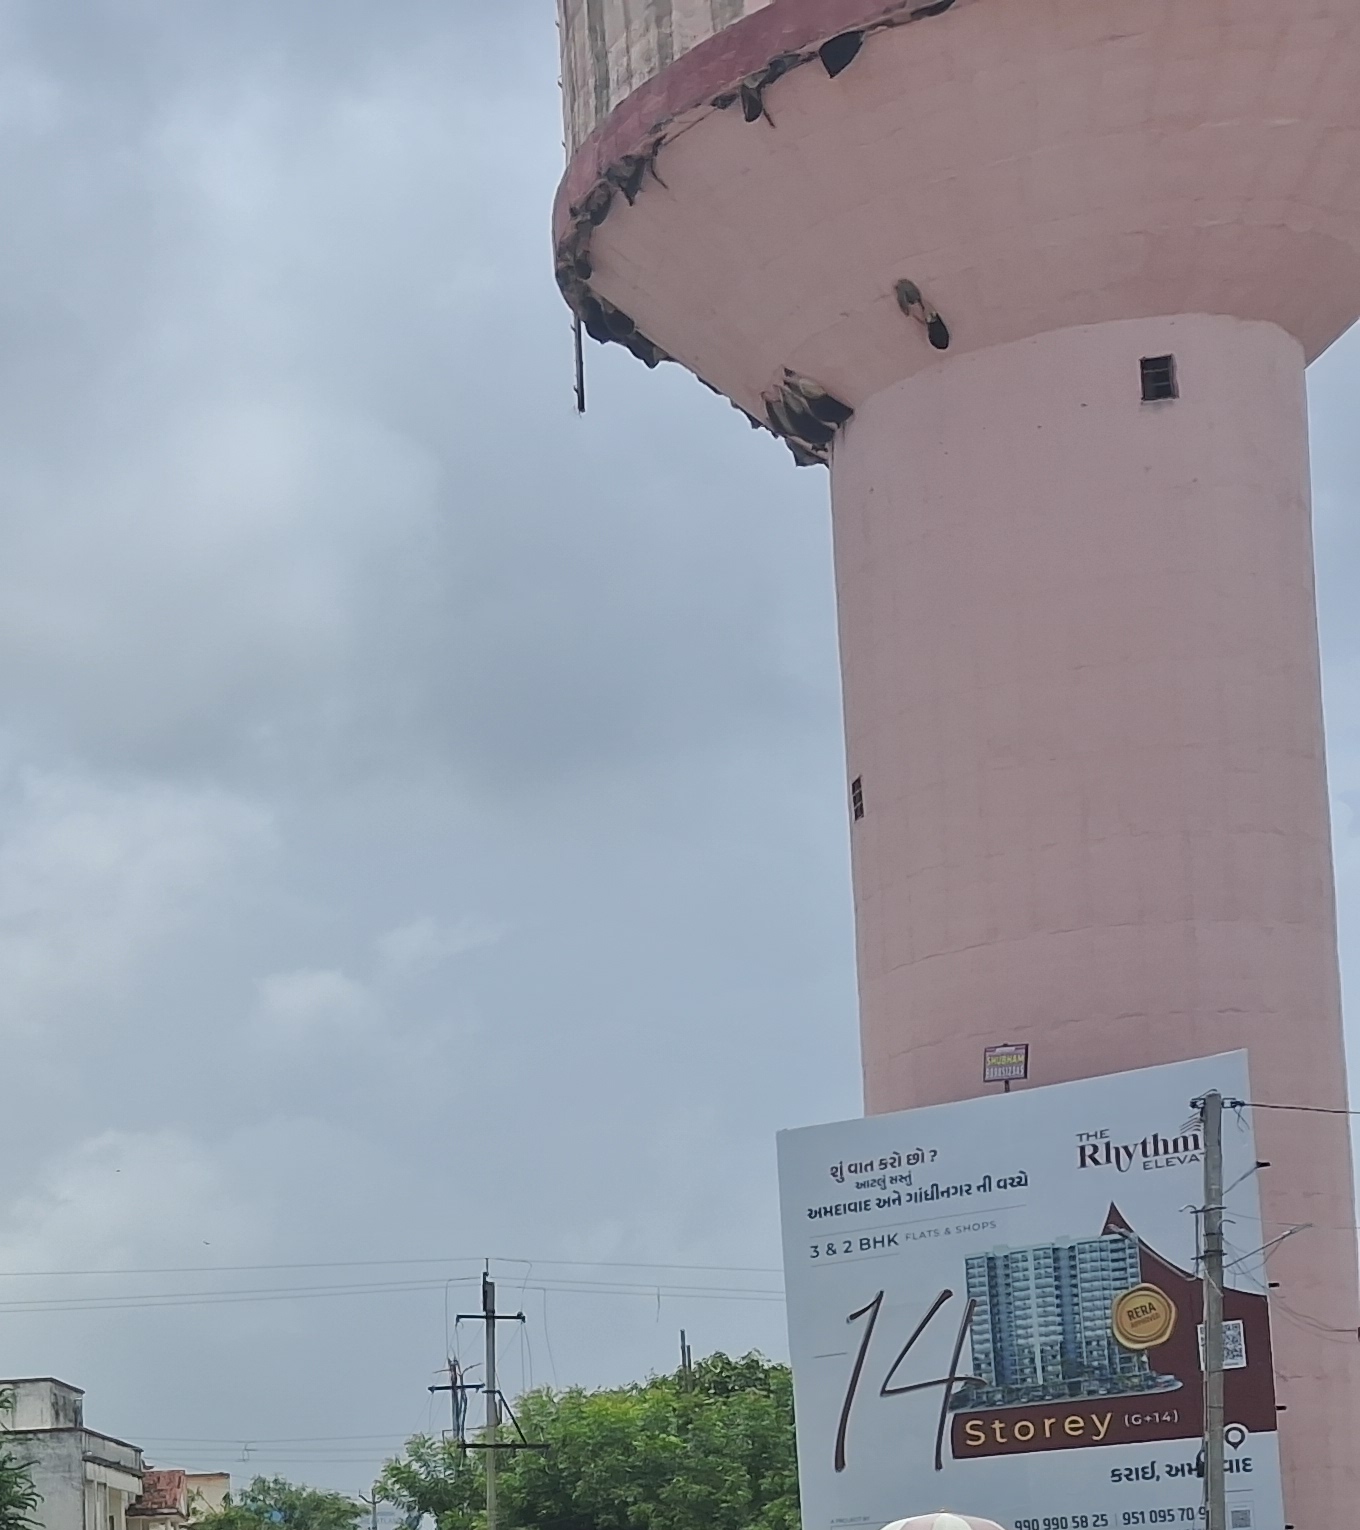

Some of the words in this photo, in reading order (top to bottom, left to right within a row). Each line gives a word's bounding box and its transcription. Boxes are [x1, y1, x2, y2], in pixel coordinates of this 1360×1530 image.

[1076, 1129, 1110, 1142] THE
[848, 1159, 874, 1175] વાત
[878, 1151, 902, 1171] કરો
[906, 1148, 925, 1167] છો
[1077, 1132, 1203, 1172] Rhythm
[1143, 1152, 1206, 1170] ELEVA
[807, 1199, 872, 1220] અમદાવાદ
[875, 1190, 902, 1209] અને
[905, 1183, 973, 1205] ગાંધીનગર
[976, 1175, 992, 1193] ની
[810, 1246, 820, 1259] 3
[825, 1243, 837, 1256] &
[843, 1240, 853, 1254] 2
[859, 1233, 899, 1251] BHK
[905, 1228, 940, 1242] FLATS
[956, 1220, 997, 1235] SHOPS
[1127, 1302, 1156, 1321] RERA
[835, 1289, 988, 1473] 14
[965, 1411, 1113, 1447] Storey
[1124, 1409, 1180, 1427] (G+14)
[1042, 1516, 1068, 1530] 990
[1072, 1515, 1088, 1529] 58
[1092, 1513, 1108, 1528] 25
[1122, 1511, 1146, 1526] 951
[1149, 1509, 1175, 1524] 095
[1178, 1507, 1194, 1522] 70
